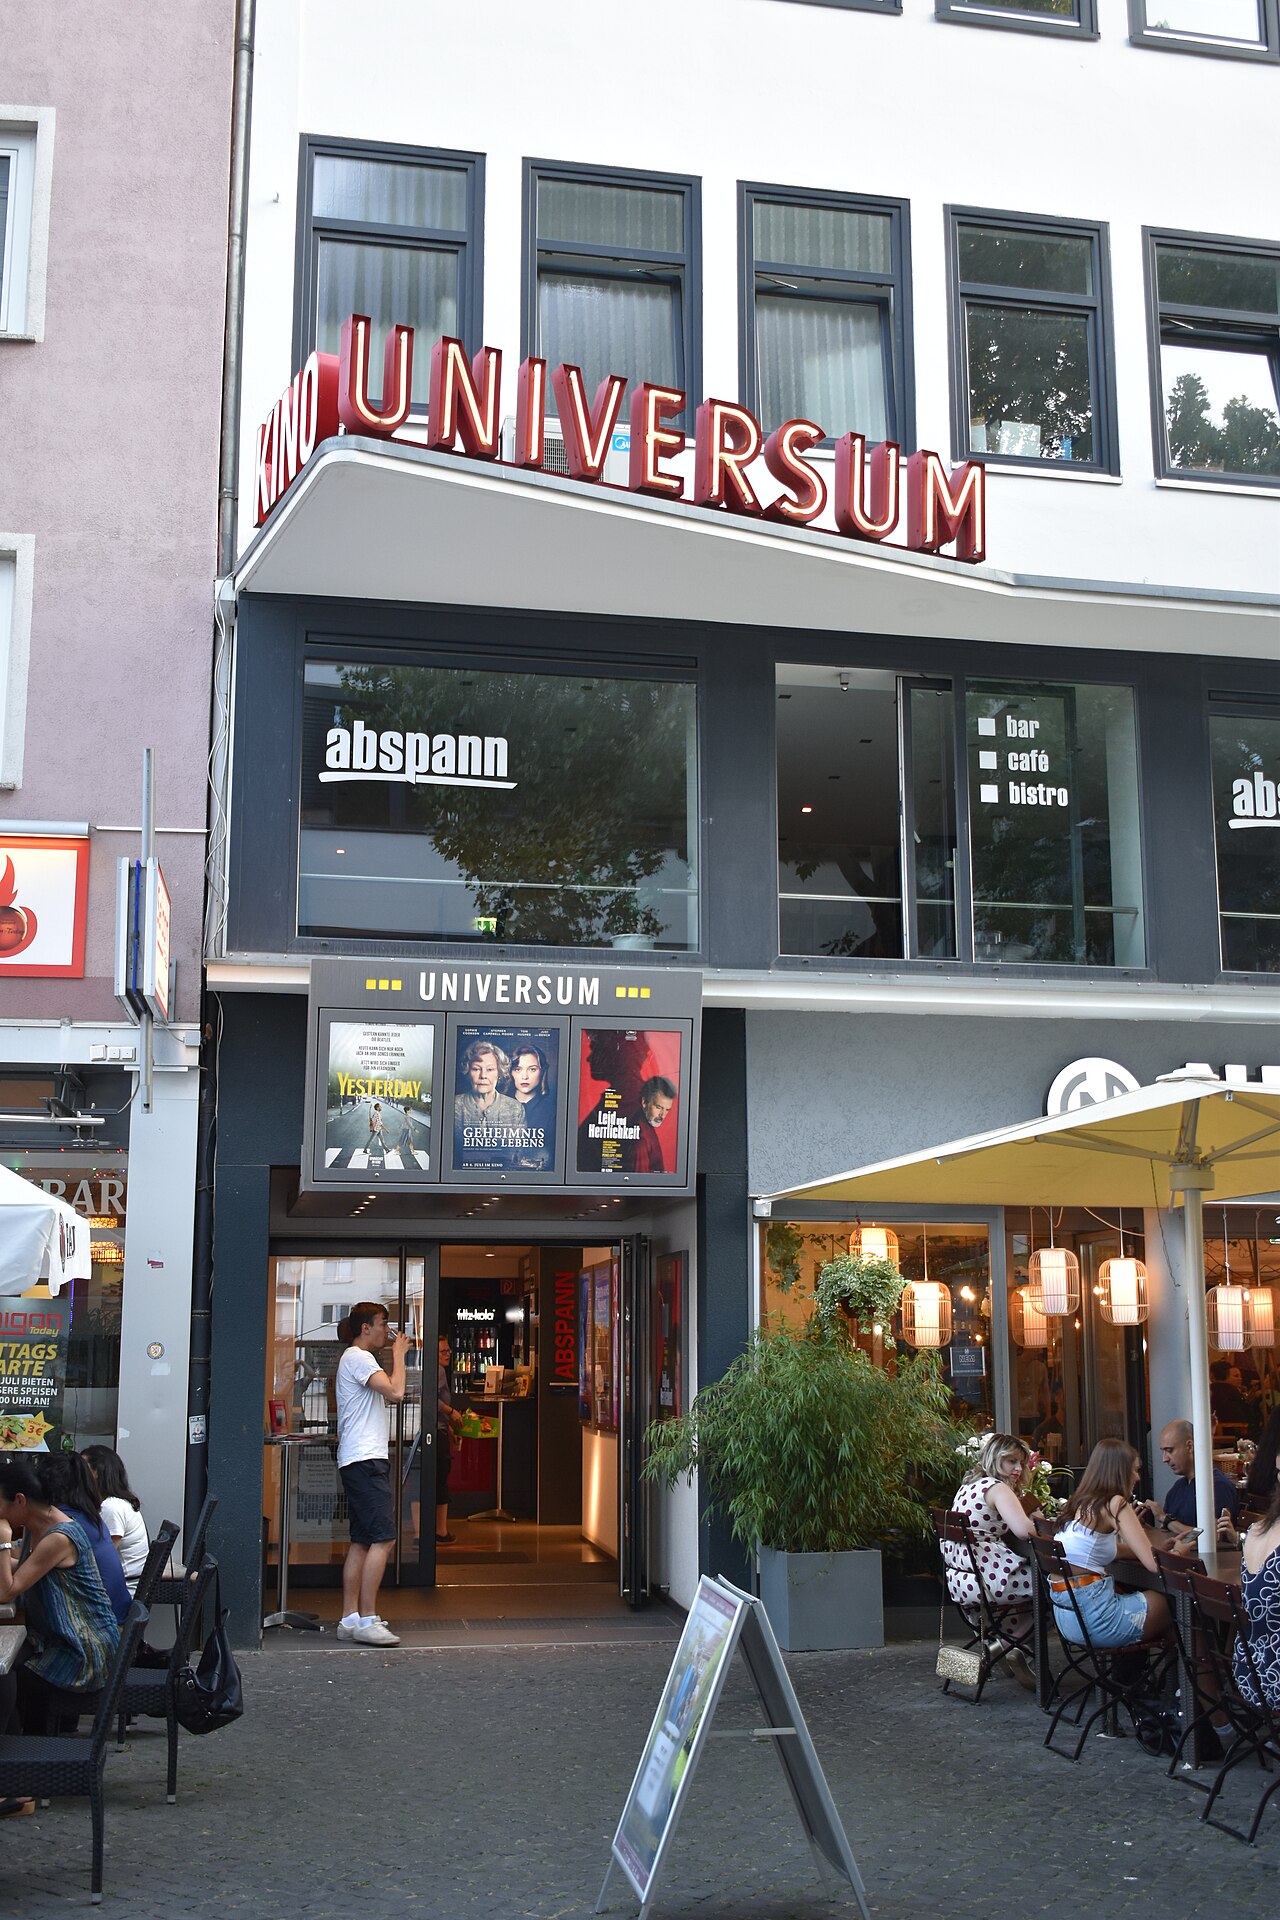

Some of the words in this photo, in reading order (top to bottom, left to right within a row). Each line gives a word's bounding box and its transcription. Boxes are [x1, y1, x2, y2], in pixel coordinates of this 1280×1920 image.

[253, 350, 324, 528] KINO
[338, 313, 986, 564] UNIVERSUM
[1006, 715, 1040, 739] bar
[325, 720, 509, 785] abspann
[1007, 750, 1050, 773] café
[1008, 781, 1069, 807] bistro
[1232, 771, 1280, 818] ab
[418, 971, 600, 1006] UNIVERSUM
[337, 1072, 422, 1099] YESTERDAY
[598, 1110, 616, 1125] Leid
[463, 1127, 545, 1139] GEHEIMNIS
[463, 1138, 498, 1147] EINES
[501, 1138, 545, 1148] LEBENS
[588, 1123, 641, 1140] Herrlichkeit
[0, 1307, 63, 1336] igon
[30, 1326, 59, 1338] Today
[555, 1271, 575, 1379] ABSPANN
[0, 1377, 20, 1385] JULI
[22, 1377, 54, 1386] BIETEN
[20, 1387, 58, 1396] SPEISEN
[12, 1396, 32, 1405] UHR
[33, 1397, 50, 1406] AN!
